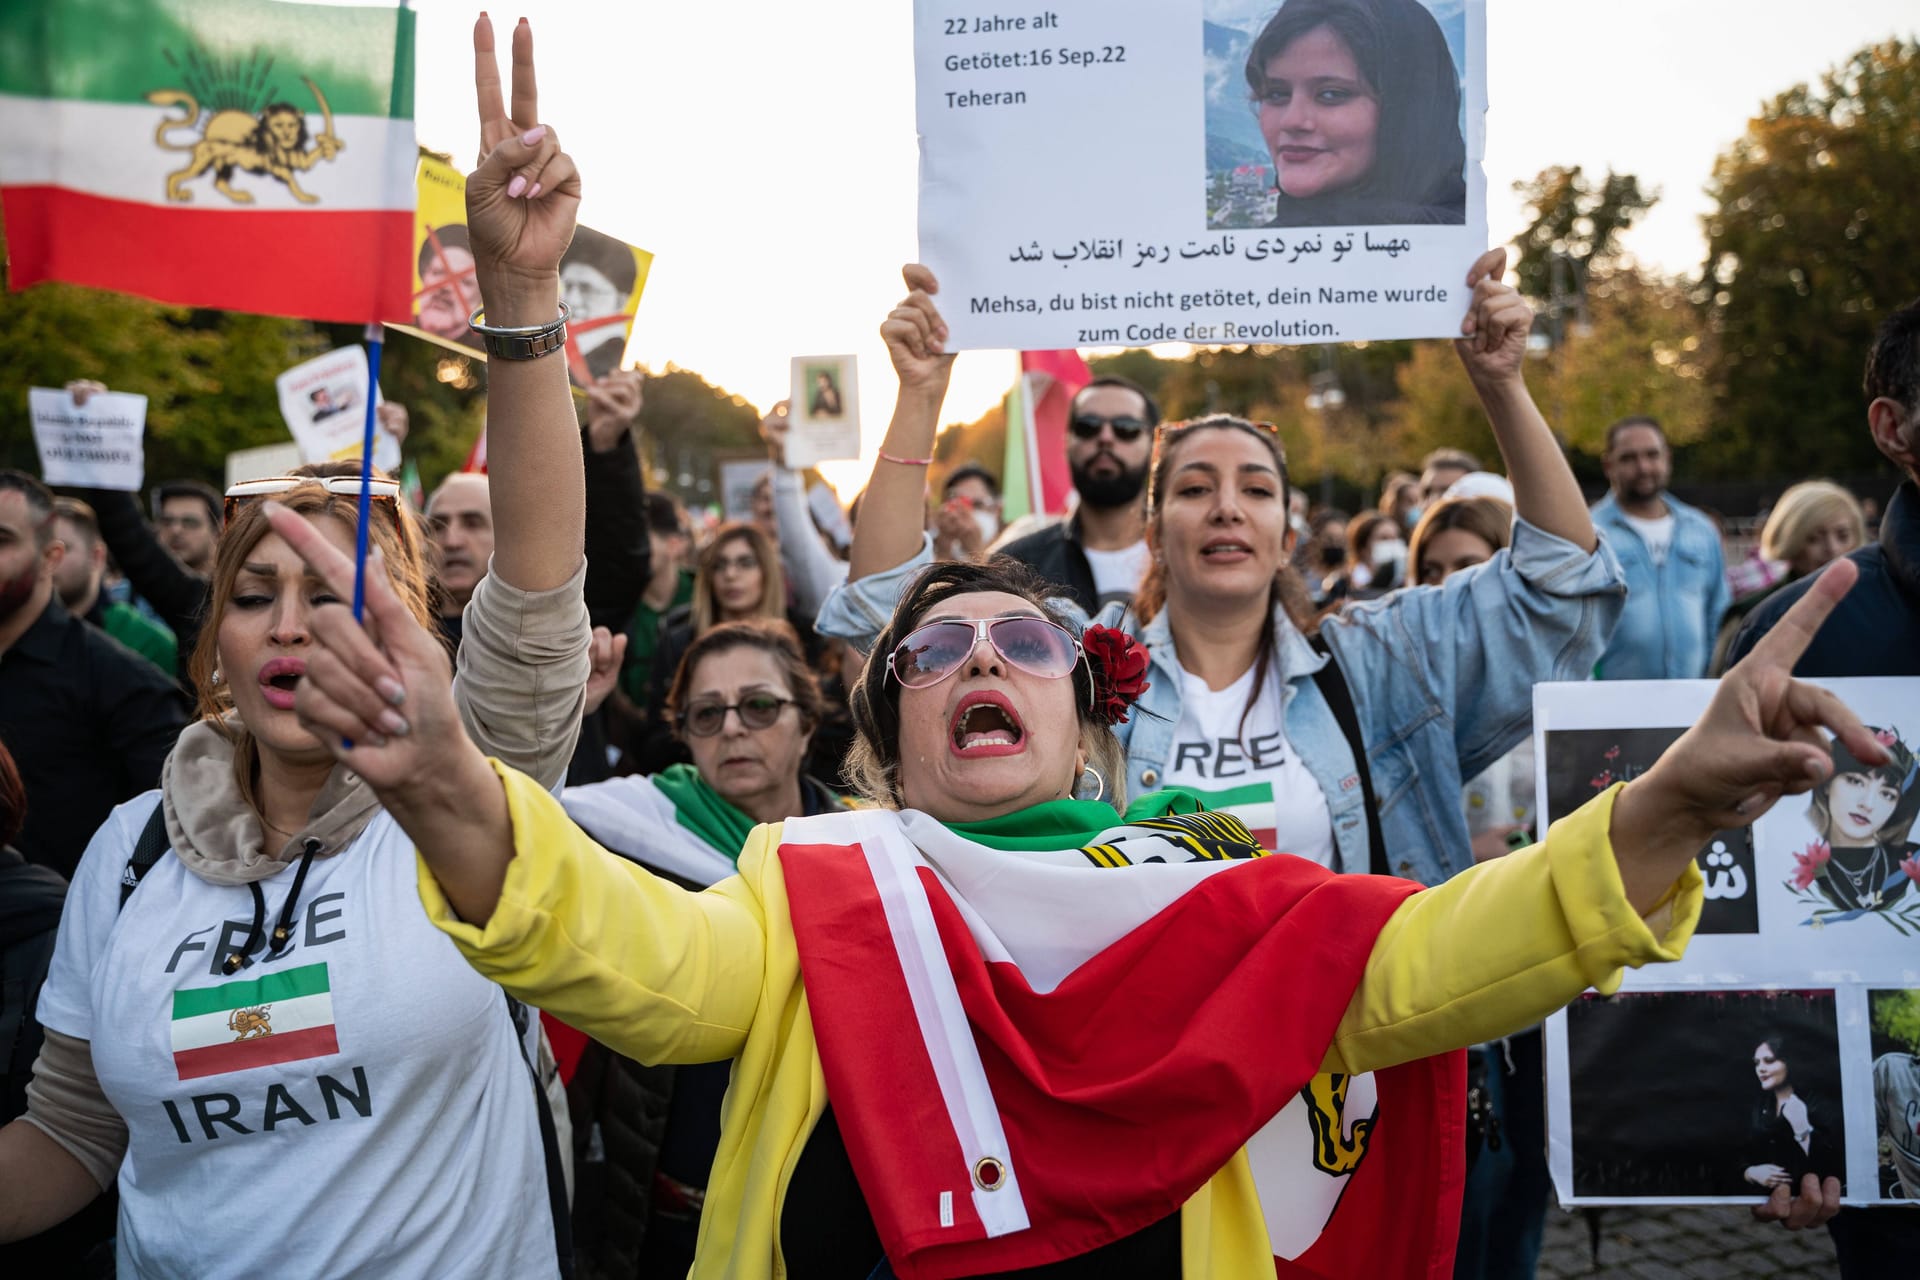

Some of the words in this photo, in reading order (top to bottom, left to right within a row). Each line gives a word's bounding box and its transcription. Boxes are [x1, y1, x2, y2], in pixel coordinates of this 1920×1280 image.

[944, 18, 968, 36] 22
[972, 15, 1027, 34] Jahre
[1032, 11, 1059, 30] alt
[944, 48, 1053, 72] Getötet:16
[1058, 45, 1127, 68] Sep.22
[944, 89, 1027, 109] Teheran
[1009, 240, 1043, 262] شد
[1052, 238, 1123, 269] انقلاب
[1132, 241, 1170, 268] رمز
[1179, 235, 1235, 259] نامت
[1244, 233, 1322, 263] نمردی
[1332, 232, 1354, 262] تو
[1364, 231, 1411, 258] مهسا
[970, 295, 1043, 315] Mehsa,
[1049, 293, 1074, 311] du
[1081, 293, 1118, 310] bist
[1124, 290, 1174, 309] nicht
[1180, 289, 1261, 312] getötet,
[1267, 287, 1312, 305] dein
[1318, 287, 1378, 304] Name
[1384, 285, 1448, 303] wurde
[1078, 327, 1120, 342] zum
[1126, 323, 1177, 341] Code
[1183, 322, 1217, 340] der
[1223, 319, 1340, 339] Revolution.
[1174, 731, 1286, 779] REE
[161, 1066, 372, 1144] IRAN
